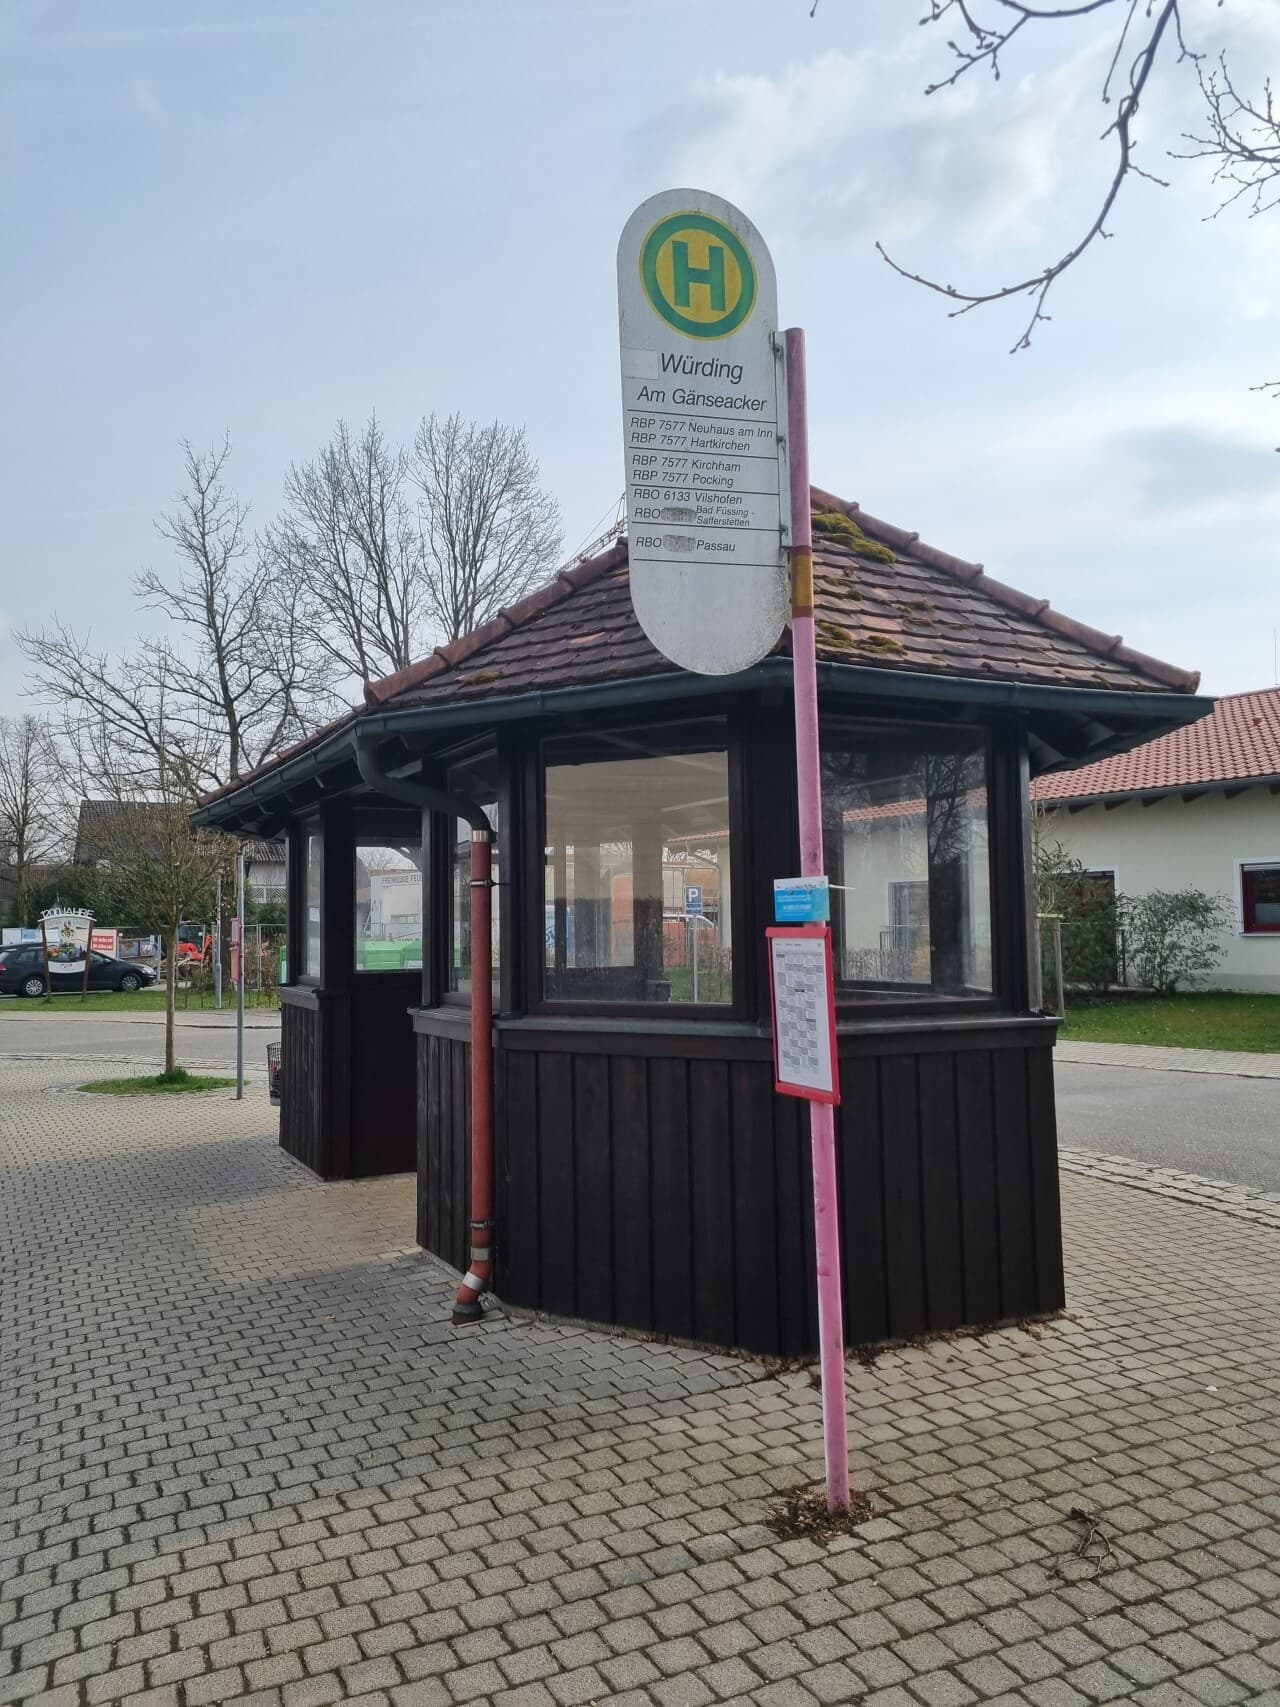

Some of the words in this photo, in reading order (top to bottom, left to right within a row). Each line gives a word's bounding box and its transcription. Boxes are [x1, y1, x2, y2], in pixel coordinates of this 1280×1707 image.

[672, 240, 726, 312] H
[661, 352, 744, 385] Würding
[637, 385, 666, 403] Am
[672, 388, 767, 411] Gänseacker
[630, 417, 656, 429] RBP
[659, 420, 685, 431] 7577
[688, 422, 735, 436] Neuhaus
[738, 428, 754, 437] am
[757, 427, 773, 439] Inn
[631, 432, 656, 443] RBP
[660, 435, 687, 446] 7577
[690, 437, 750, 451] Hartkirchen
[632, 454, 657, 466] RBP
[662, 457, 688, 468] 7577
[691, 459, 741, 472] Kirchham
[633, 469, 658, 481] RBP
[662, 471, 688, 483] 7577
[692, 473, 734, 488] Pocking
[634, 488, 660, 500] RBO
[664, 490, 690, 502] 6133
[695, 491, 742, 505] Vilshofen
[634, 507, 661, 519] RBO
[696, 505, 713, 514] Bad
[636, 536, 662, 548] RBO
[696, 540, 736, 552] Passau
[688, 888, 699, 902] P
[62, 907, 95, 917] JAHRE
